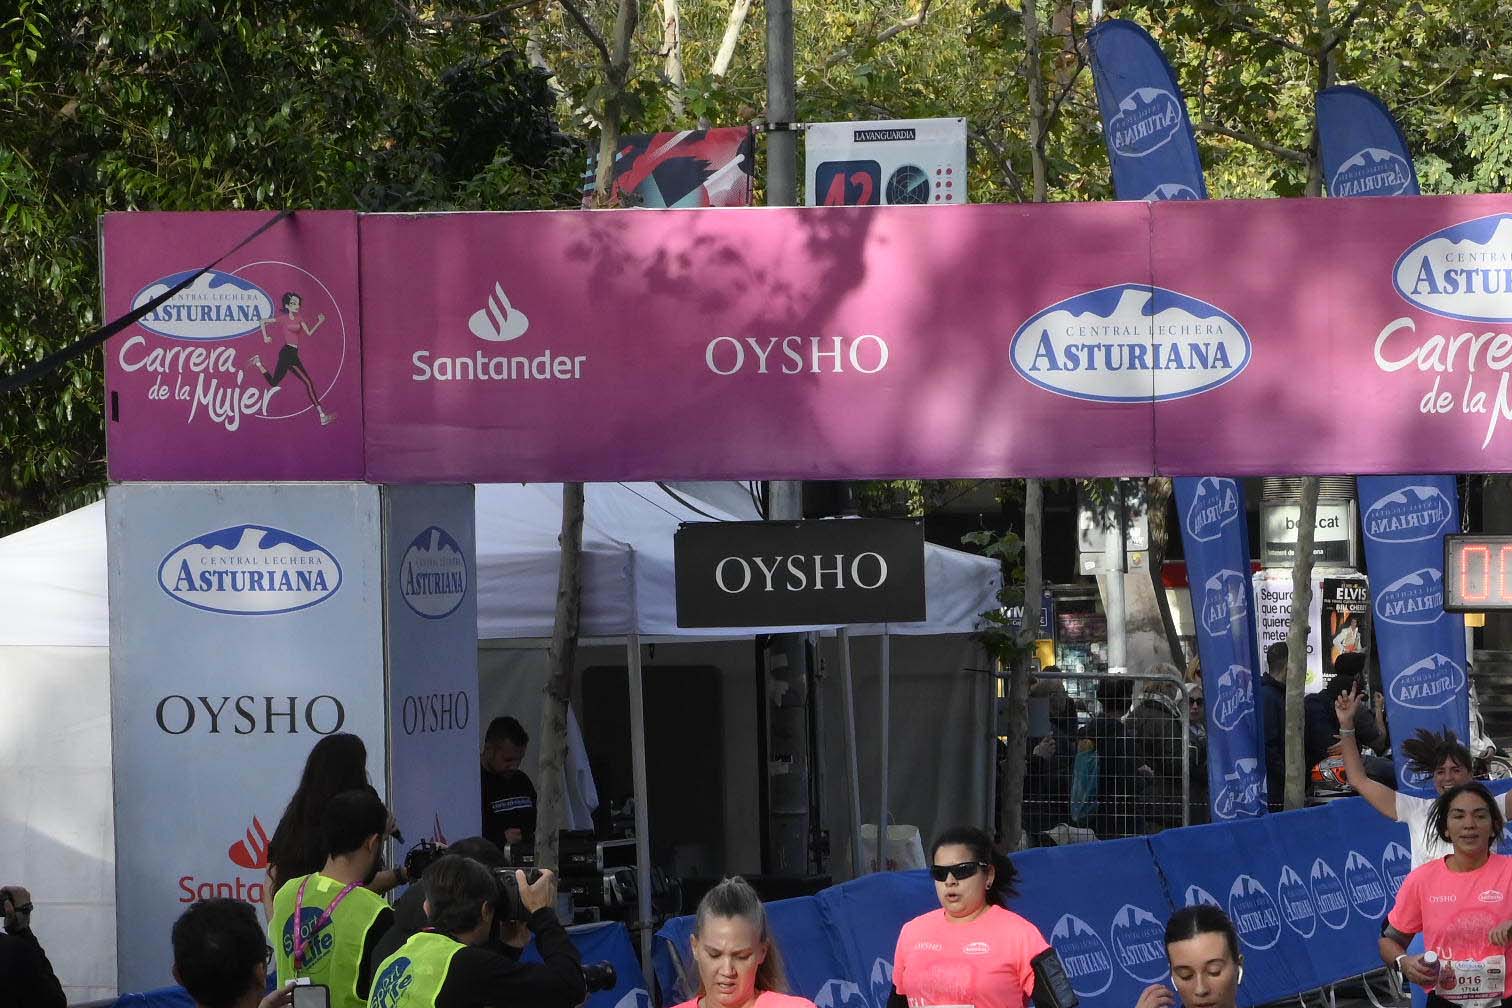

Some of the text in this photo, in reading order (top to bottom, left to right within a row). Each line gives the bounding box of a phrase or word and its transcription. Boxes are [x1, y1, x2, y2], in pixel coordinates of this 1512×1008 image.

[172, 293, 207, 301] ENTRAL
[1066, 325, 1224, 337] CENTRAL LECHERA
[118, 336, 237, 373] Carrera
[412, 348, 587, 382] Santander
[705, 334, 889, 376] OYSHO
[1029, 329, 1232, 372] ASTURIANA
[149, 369, 282, 432] de la Mujer
[1420, 375, 1453, 414] de
[1462, 374, 1487, 413] la
[1285, 515, 1339, 530] b.cat
[172, 558, 329, 592] ASTURIANA
[201, 556, 323, 565] CENTRAL LECHERA
[714, 552, 888, 594] OYSHO
[405, 563, 464, 597] ASTURIANA
[1336, 588, 1367, 600] ELVIS
[1261, 604, 1279, 616] que
[155, 694, 346, 735] OYSHO
[402, 691, 470, 735] OYSHO
[179, 876, 265, 904] Santa
[283, 914, 319, 952] Sort
[1458, 975, 1482, 985] 016
